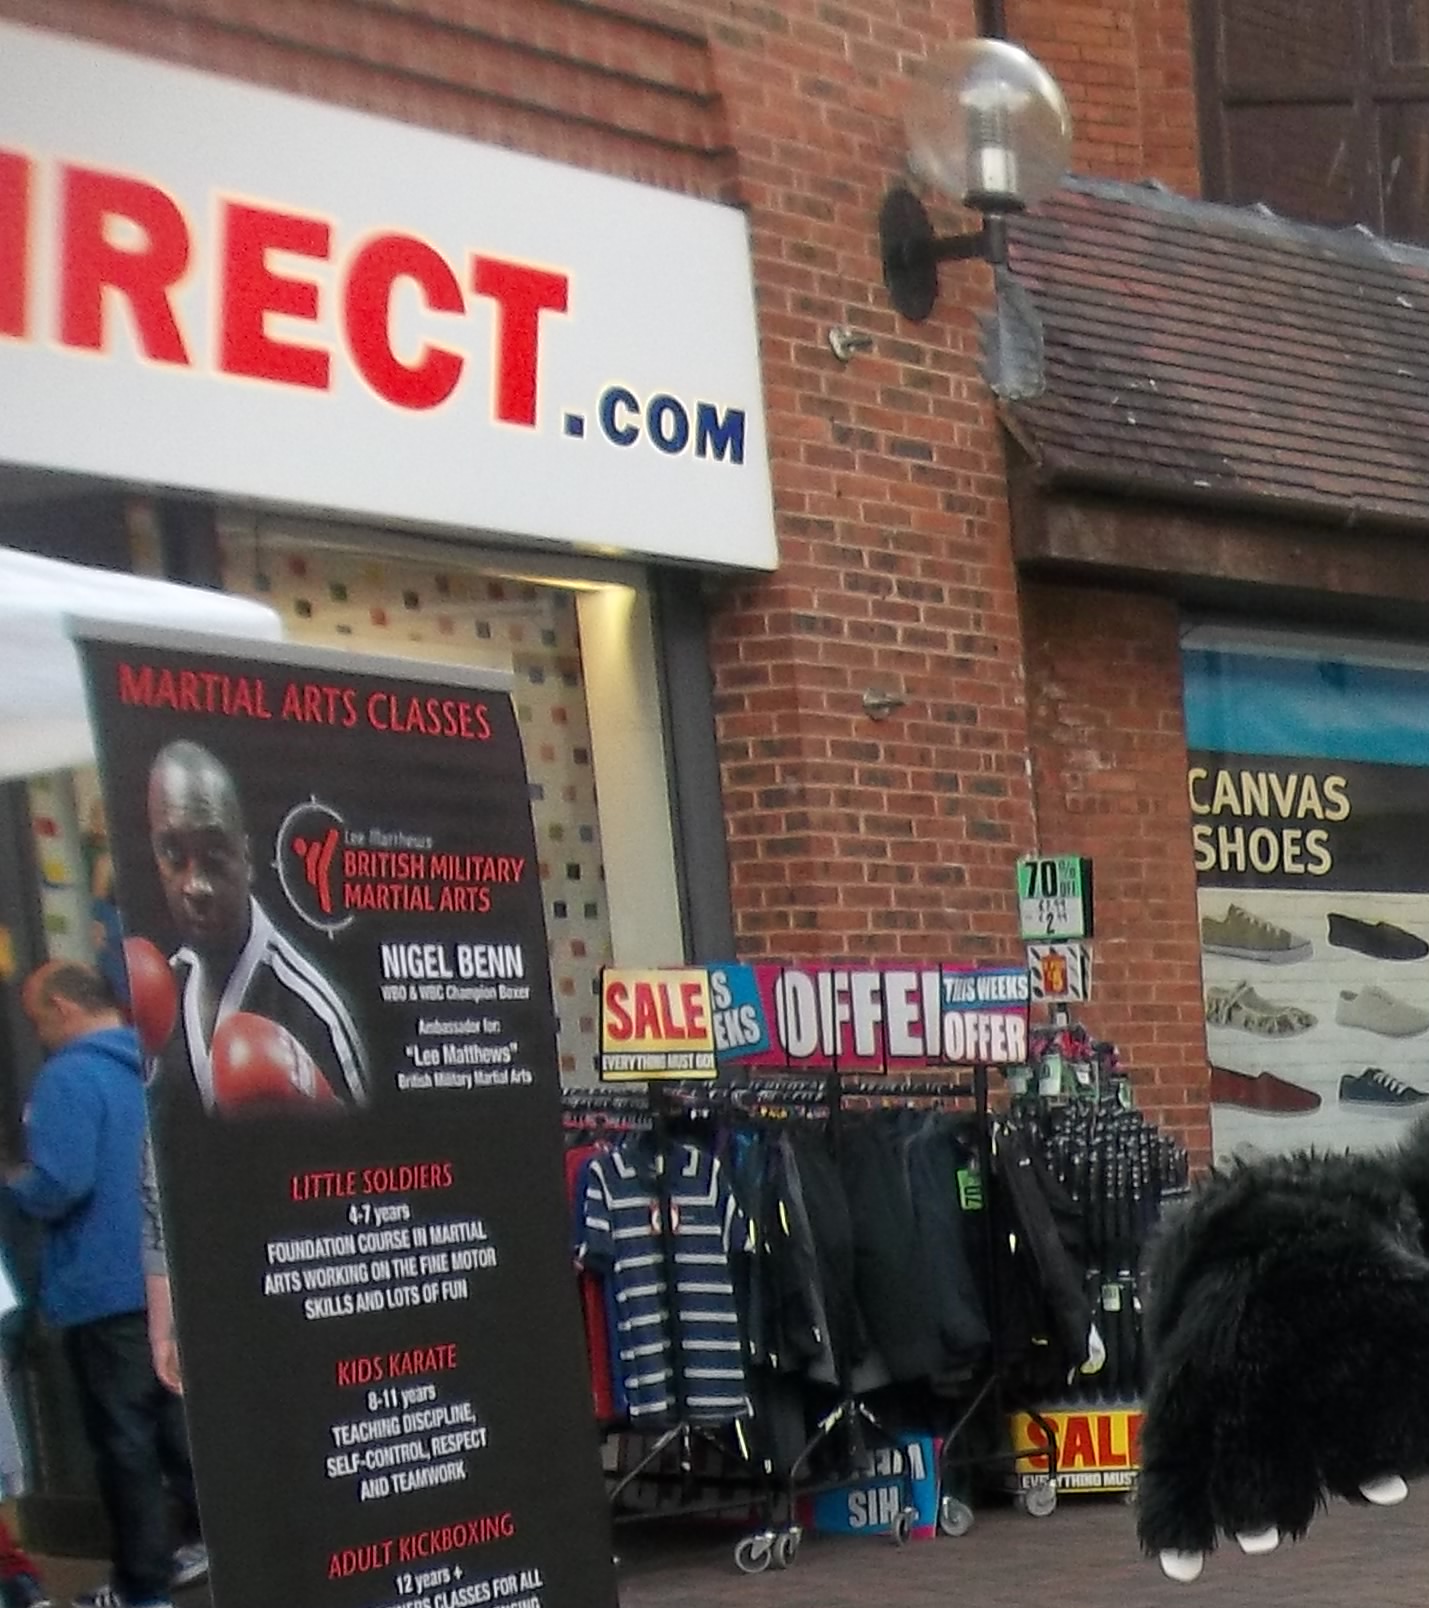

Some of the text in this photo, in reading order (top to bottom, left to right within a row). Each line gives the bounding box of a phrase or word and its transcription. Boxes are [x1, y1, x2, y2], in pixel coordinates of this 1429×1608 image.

[118, 662, 491, 740] MARTIAL ARTS CLASSES
[1188, 768, 1351, 822] CANVAS
[345, 831, 365, 845] Lee
[1193, 825, 1333, 876] SHOES
[344, 851, 525, 882] BRITISH MILITARY
[344, 883, 491, 912] MARTIAL ARTS
[381, 944, 524, 979] NIGEL BENN
[446, 983, 497, 1004] Champion
[498, 984, 530, 1000] Boxer
[945, 977, 976, 1003] THIS
[977, 973, 1028, 1001] WEEKS
[418, 1018, 481, 1035] Ambassador
[606, 981, 708, 1041] SALE
[944, 1011, 1027, 1063] OFFER
[398, 1069, 533, 1089] British Military Martial Arts
[602, 1053, 666, 1072] EVERYTHING
[667, 1053, 694, 1071] MUST
[291, 1163, 452, 1200] LITTLE SOLDIERS
[349, 1203, 411, 1227] 4-7 years
[267, 1221, 488, 1265] FOUNDATION COURSE IN MARTIAL
[264, 1247, 497, 1296] ARTS WORKING ON THE FINE MOTOR
[304, 1279, 468, 1320] SKILLS AND LOTS OF FUN
[338, 1343, 457, 1387] KIDS KARATE
[367, 1384, 436, 1411] 8-11 years
[332, 1402, 477, 1447] TEACHING DISCIPLINE,
[326, 1427, 488, 1478] SELF-CONTROL, RESPECT
[361, 1460, 466, 1501] AND TEAMWORK
[328, 1512, 515, 1579] ADULT KICKBOXING
[396, 1574, 413, 1595] 12
[415, 1567, 450, 1595] years
[493, 1574, 518, 1598] FOR
[520, 1569, 543, 1590] ALL
